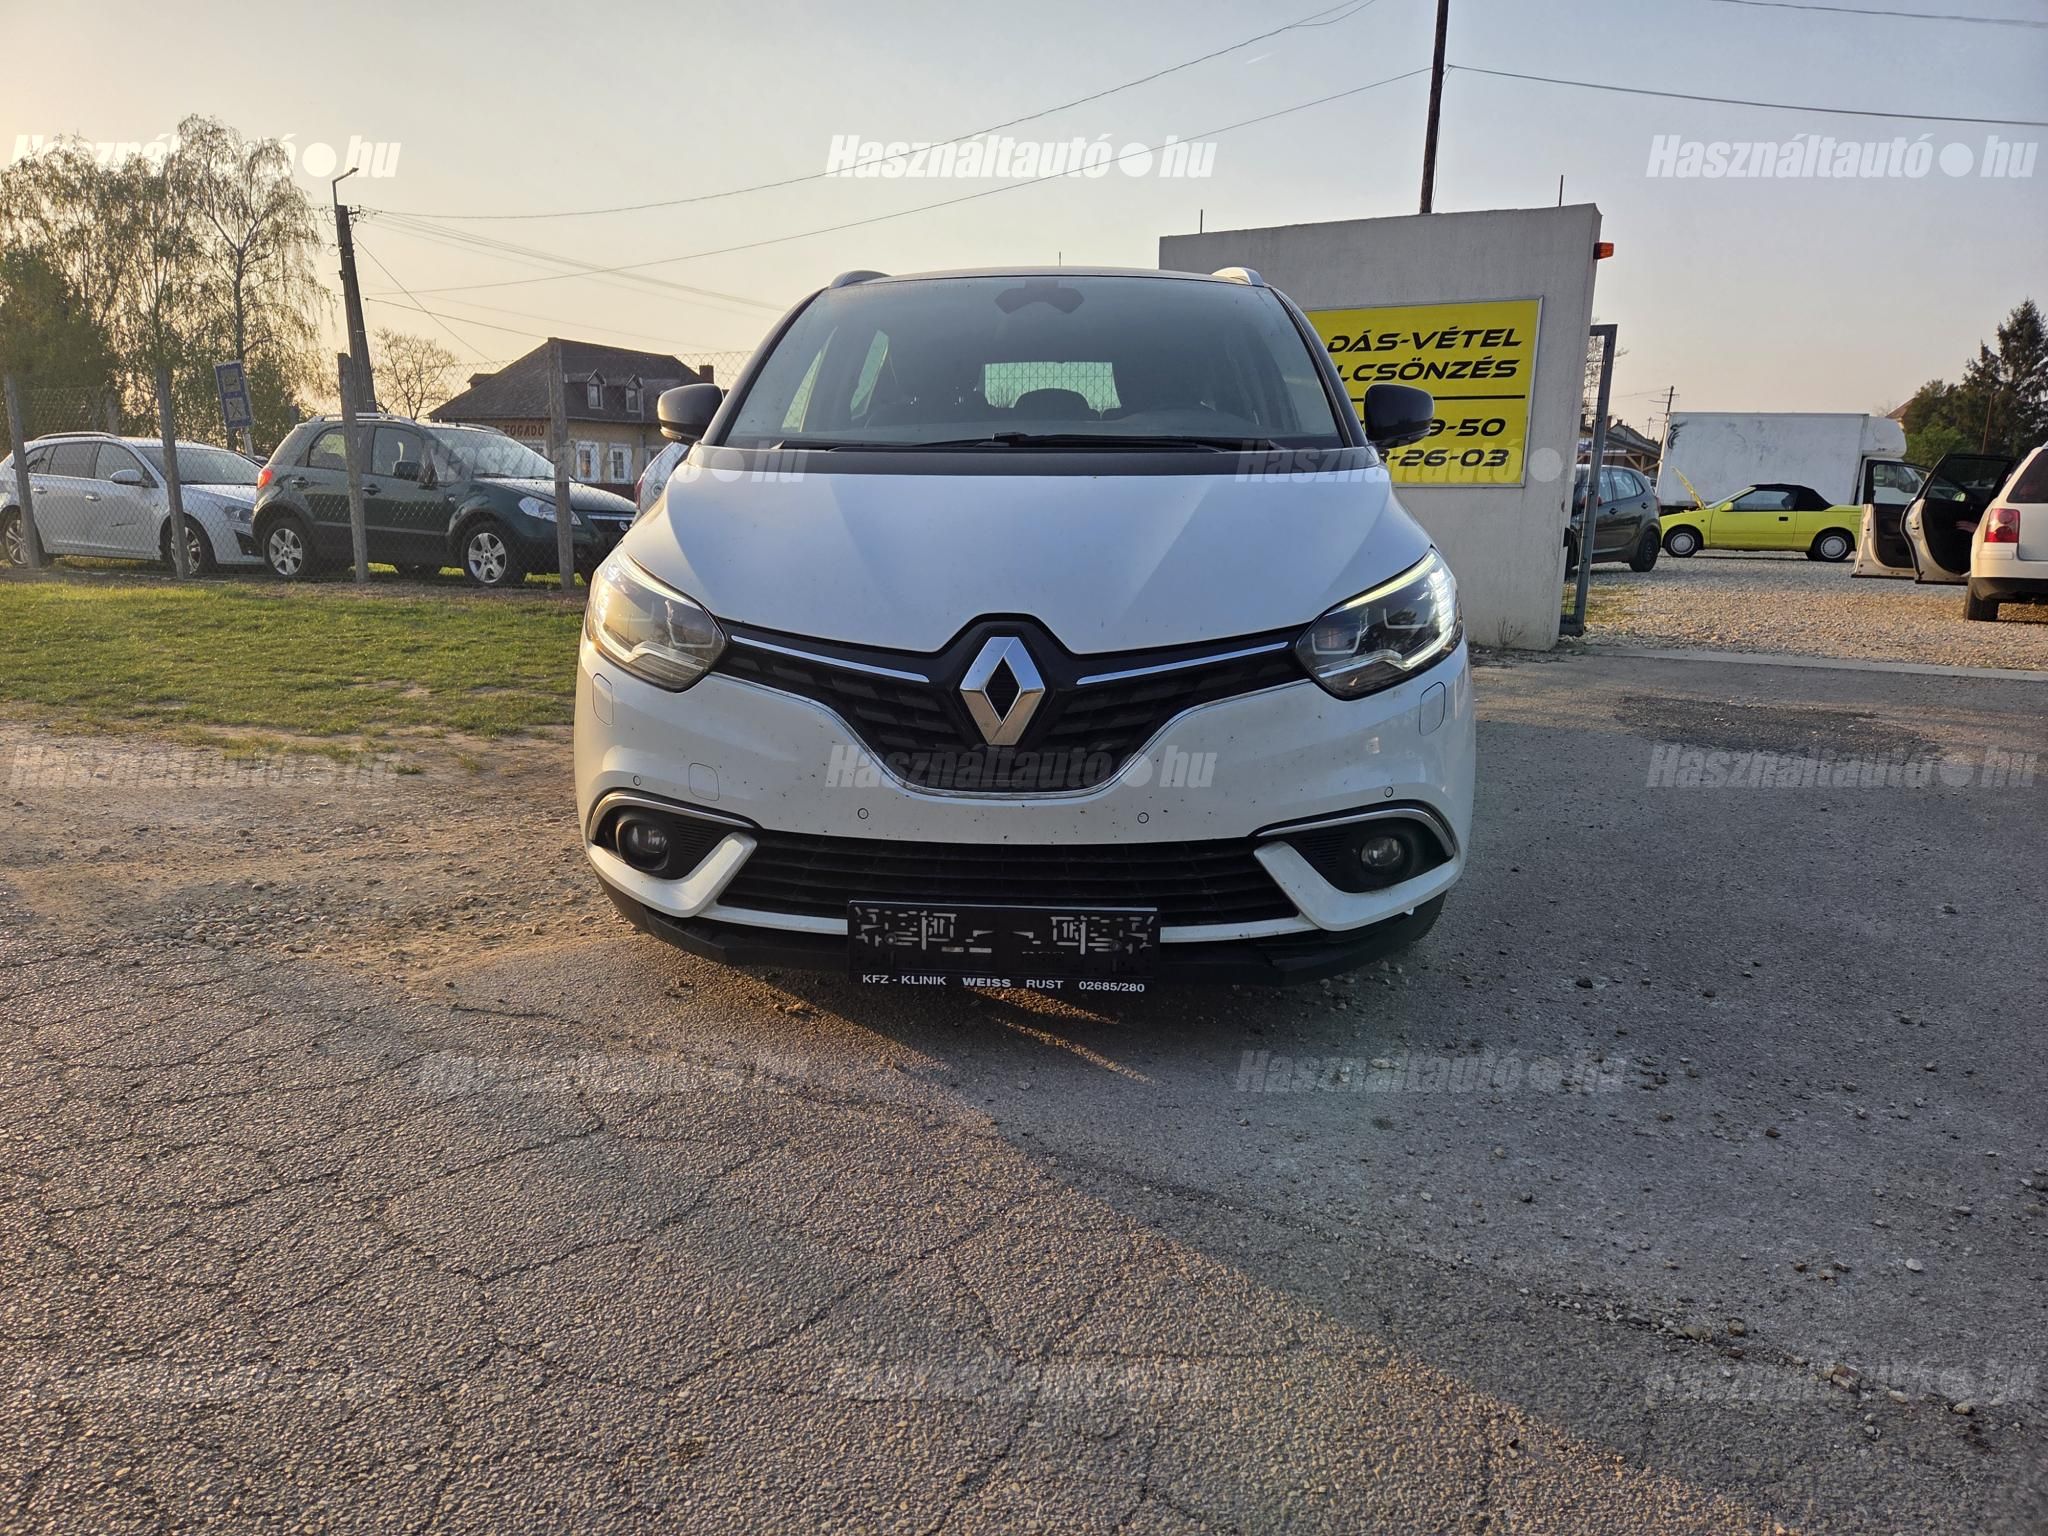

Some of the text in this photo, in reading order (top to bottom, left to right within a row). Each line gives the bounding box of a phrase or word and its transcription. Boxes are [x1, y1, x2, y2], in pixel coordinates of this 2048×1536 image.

[862, 974, 889, 984] KFZ
[901, 975, 947, 986] KLINIK
[962, 977, 1012, 988] WEISS
[1026, 979, 1064, 989] RUST
[1079, 980, 1145, 992] 02685/280
